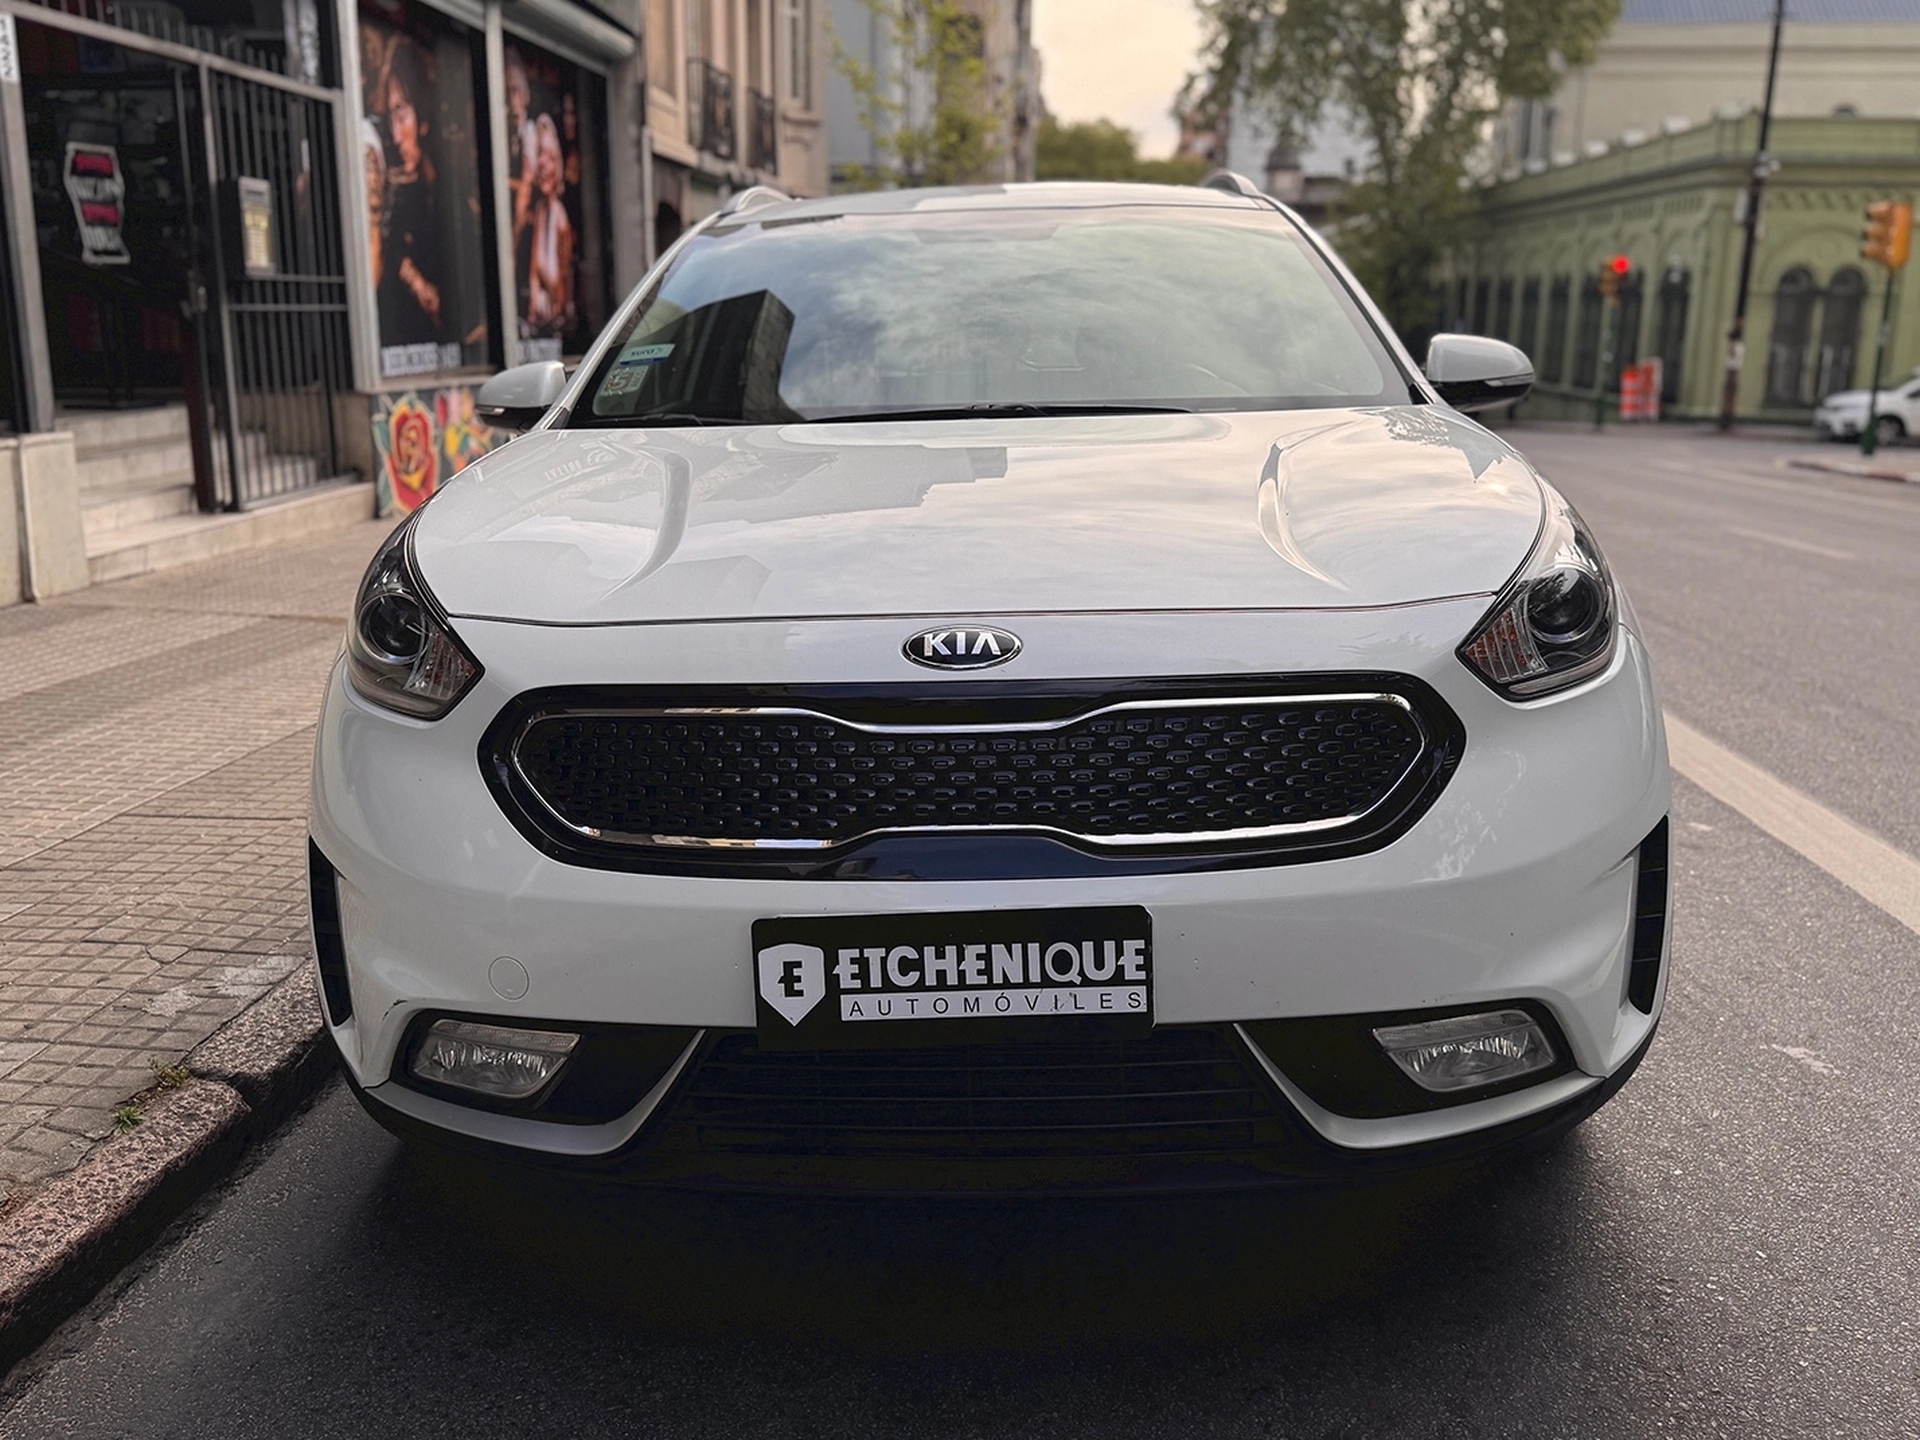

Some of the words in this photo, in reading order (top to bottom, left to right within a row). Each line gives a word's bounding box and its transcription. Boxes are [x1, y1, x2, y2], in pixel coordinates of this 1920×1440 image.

[923, 631, 1002, 657] KIA
[833, 939, 1147, 989] ETCHENIQUE
[849, 991, 1143, 1017] AUTOMÓVILES
